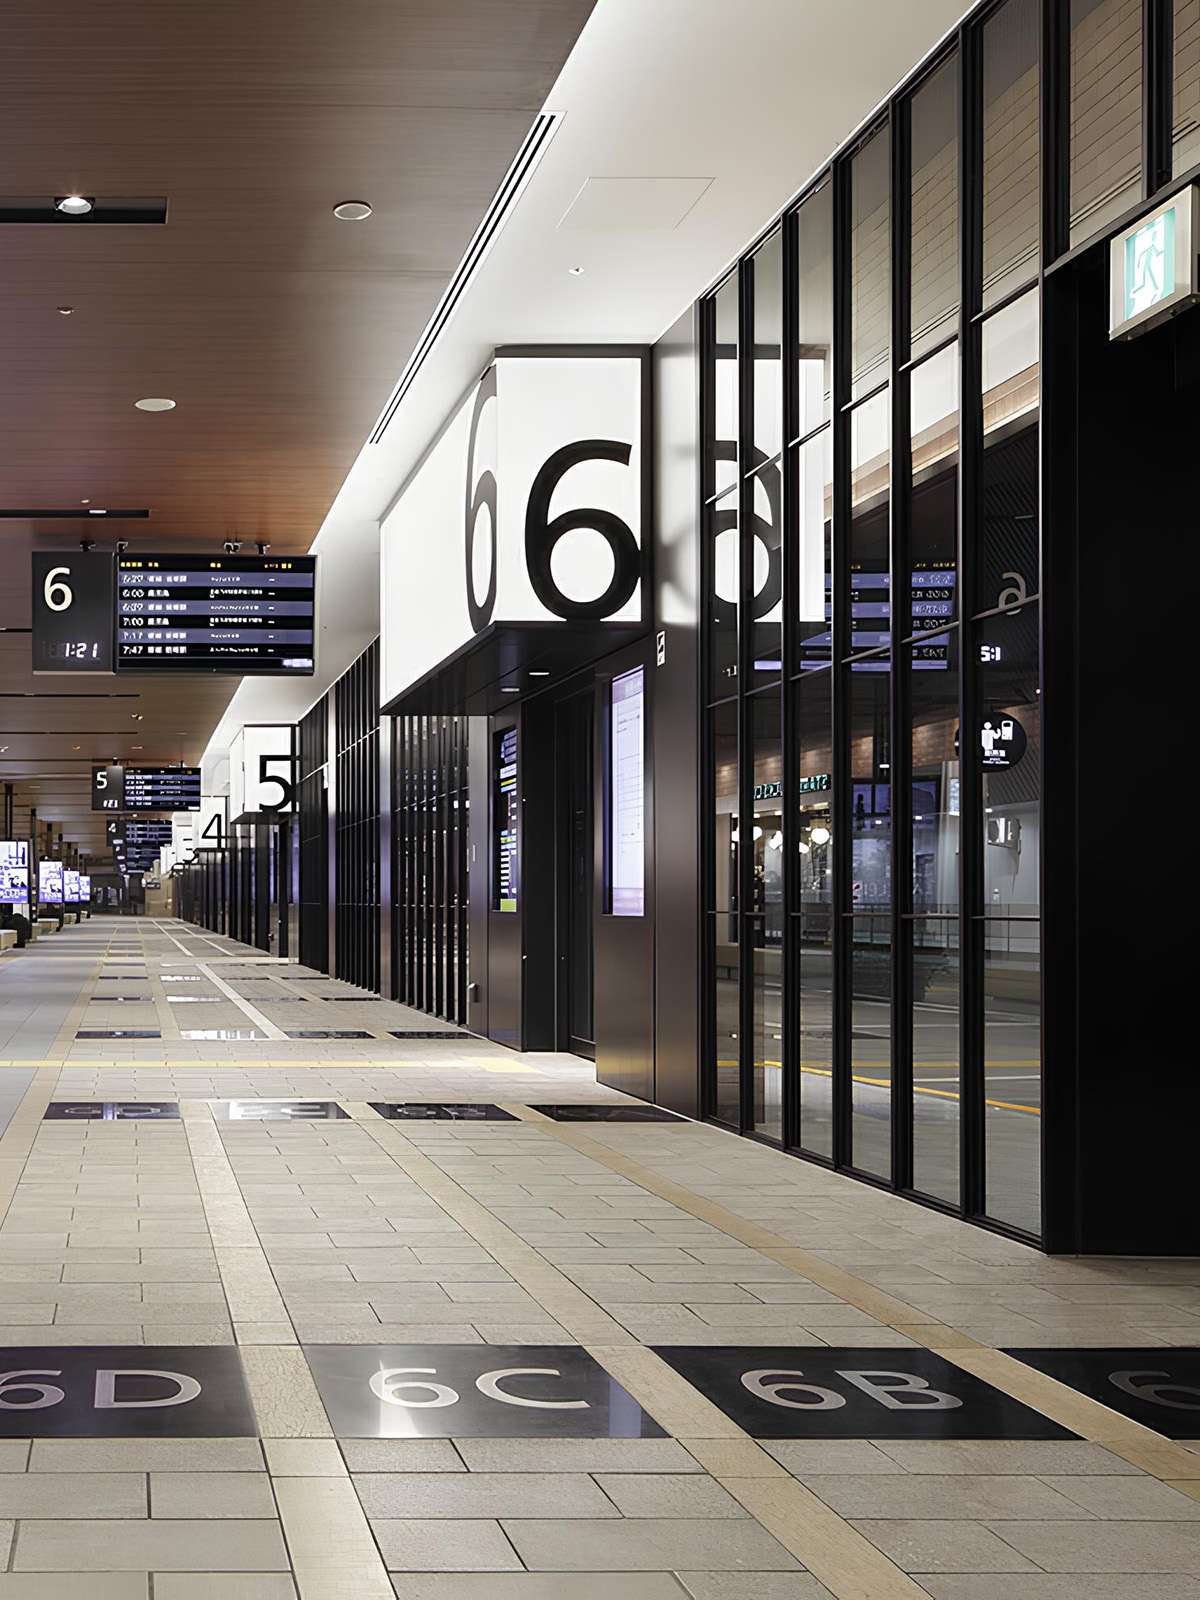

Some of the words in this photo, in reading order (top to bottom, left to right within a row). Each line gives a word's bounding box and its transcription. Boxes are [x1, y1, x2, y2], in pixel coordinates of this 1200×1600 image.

[525, 439, 642, 621] 6
[44, 566, 73, 612] 6
[65, 643, 98, 658] 1:21
[96, 771, 108, 789] 5
[259, 755, 292, 812] 5
[202, 814, 226, 848] 4
[369, 1368, 591, 1408] 6C
[740, 1369, 963, 1409] 6B
